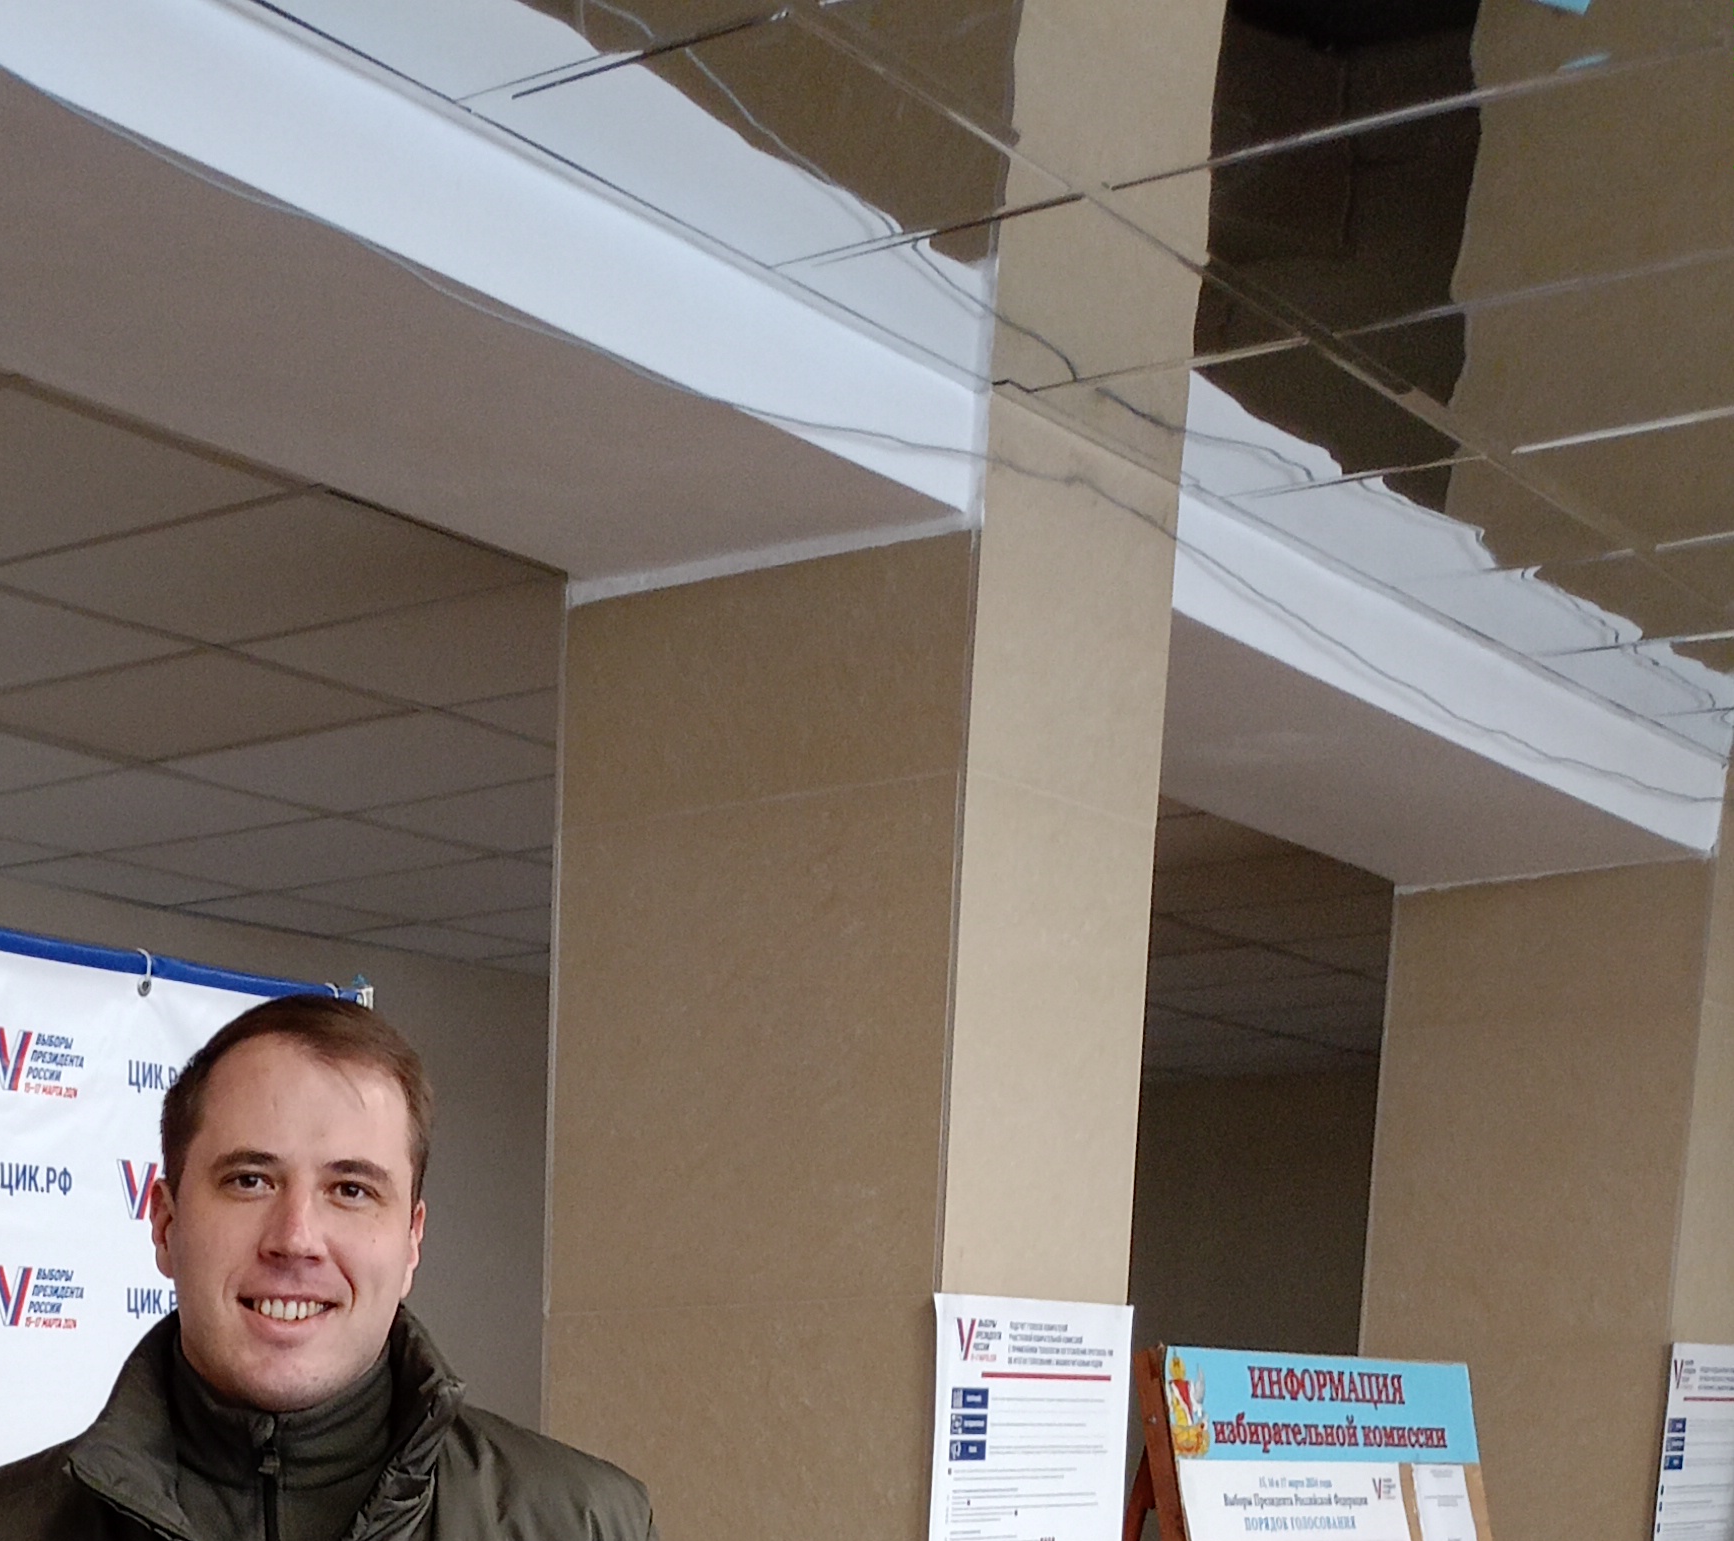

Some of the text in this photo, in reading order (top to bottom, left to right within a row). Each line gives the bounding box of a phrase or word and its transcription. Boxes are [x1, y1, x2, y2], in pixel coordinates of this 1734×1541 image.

[36, 1033, 74, 1049] ВЫБОРЫ
[30, 1049, 85, 1068] ПРЕЗИДЕНТА
[26, 1066, 62, 1082] РОССИИ
[128, 1059, 179, 1093] ЦИК.Р
[0, 1162, 73, 1196] ЦИК.РФ
[36, 1267, 74, 1282] ВЫБОРЫ
[32, 1284, 84, 1299] ПРЕЗИДЕНТА
[28, 1300, 63, 1314] РОССИИ
[127, 1287, 178, 1319] ЦИК.Р
[1247, 1365, 1405, 1409] ИНФОРМАЦИЯ
[1213, 1412, 1448, 1453] избирательной комиссии
